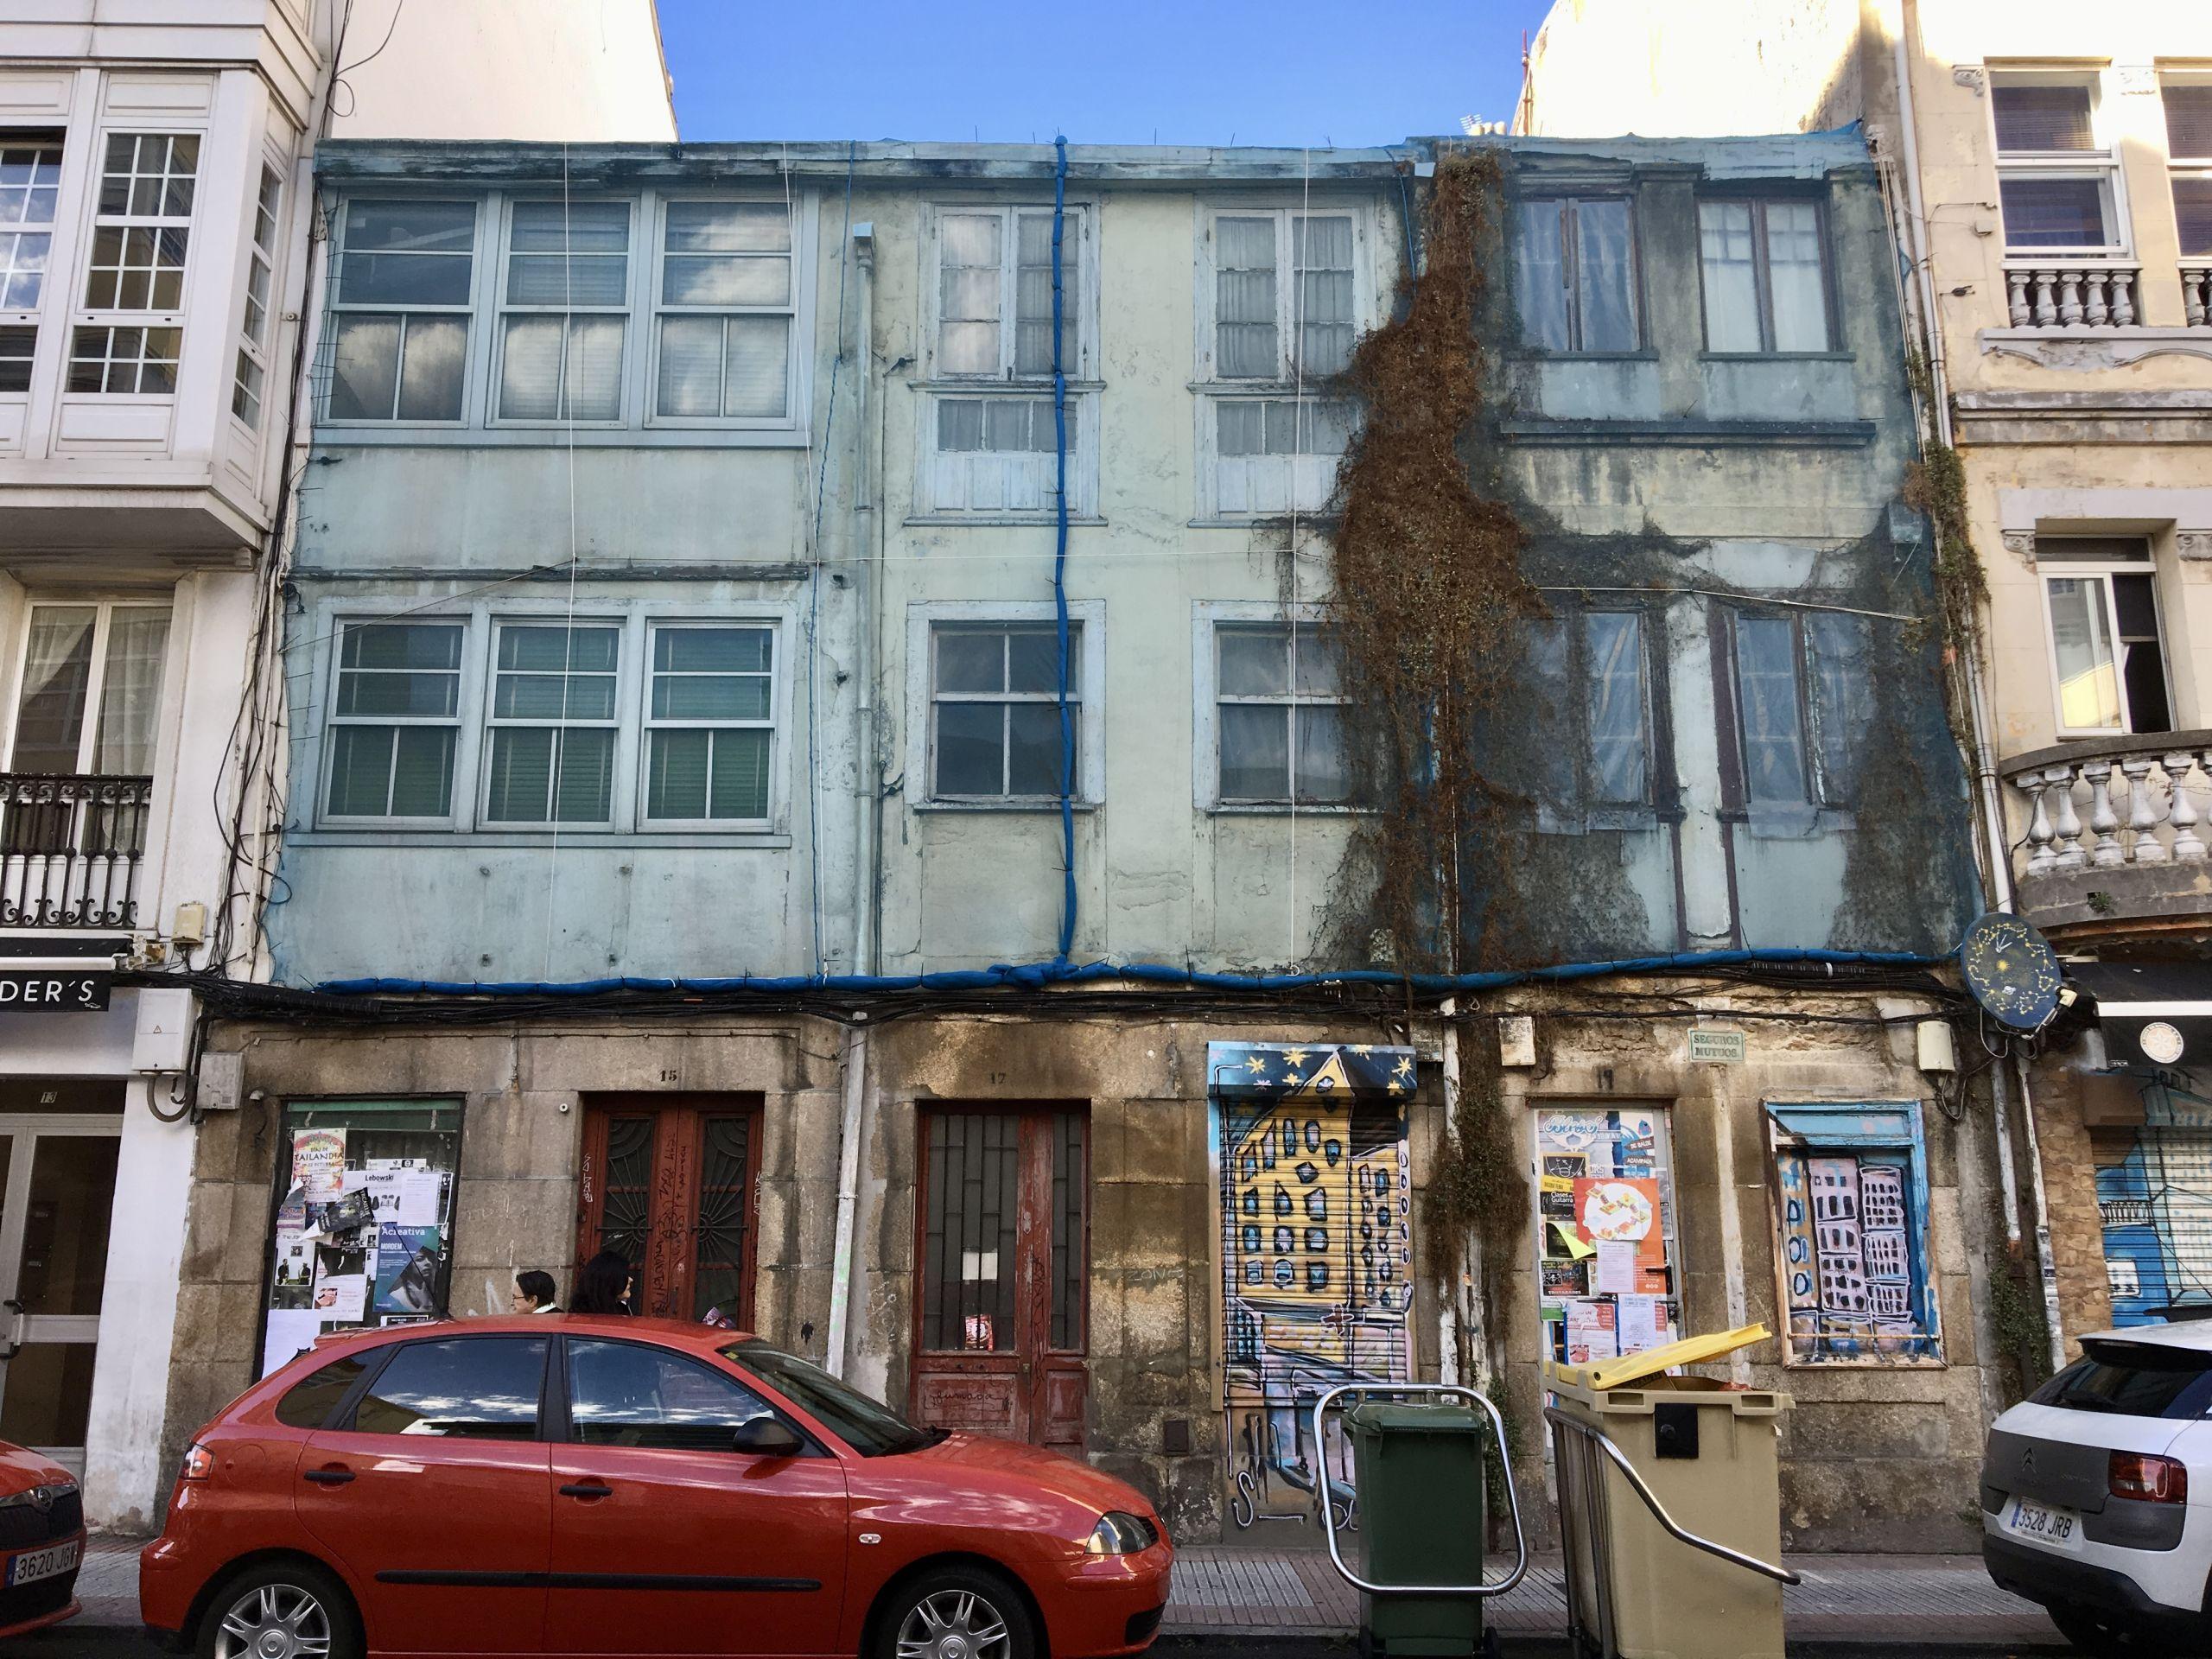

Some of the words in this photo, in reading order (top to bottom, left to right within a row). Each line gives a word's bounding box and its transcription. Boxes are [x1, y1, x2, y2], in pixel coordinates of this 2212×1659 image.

[1694, 1034, 1740, 1046] SEGUROS
[660, 1070, 677, 1082] 15
[990, 1071, 1007, 1084] 17
[295, 1152, 344, 1161] TAILANDIA
[2018, 1508, 2047, 1532] 3528
[2047, 1515, 2073, 1539] JRB
[17, 1552, 54, 1580] 3620
